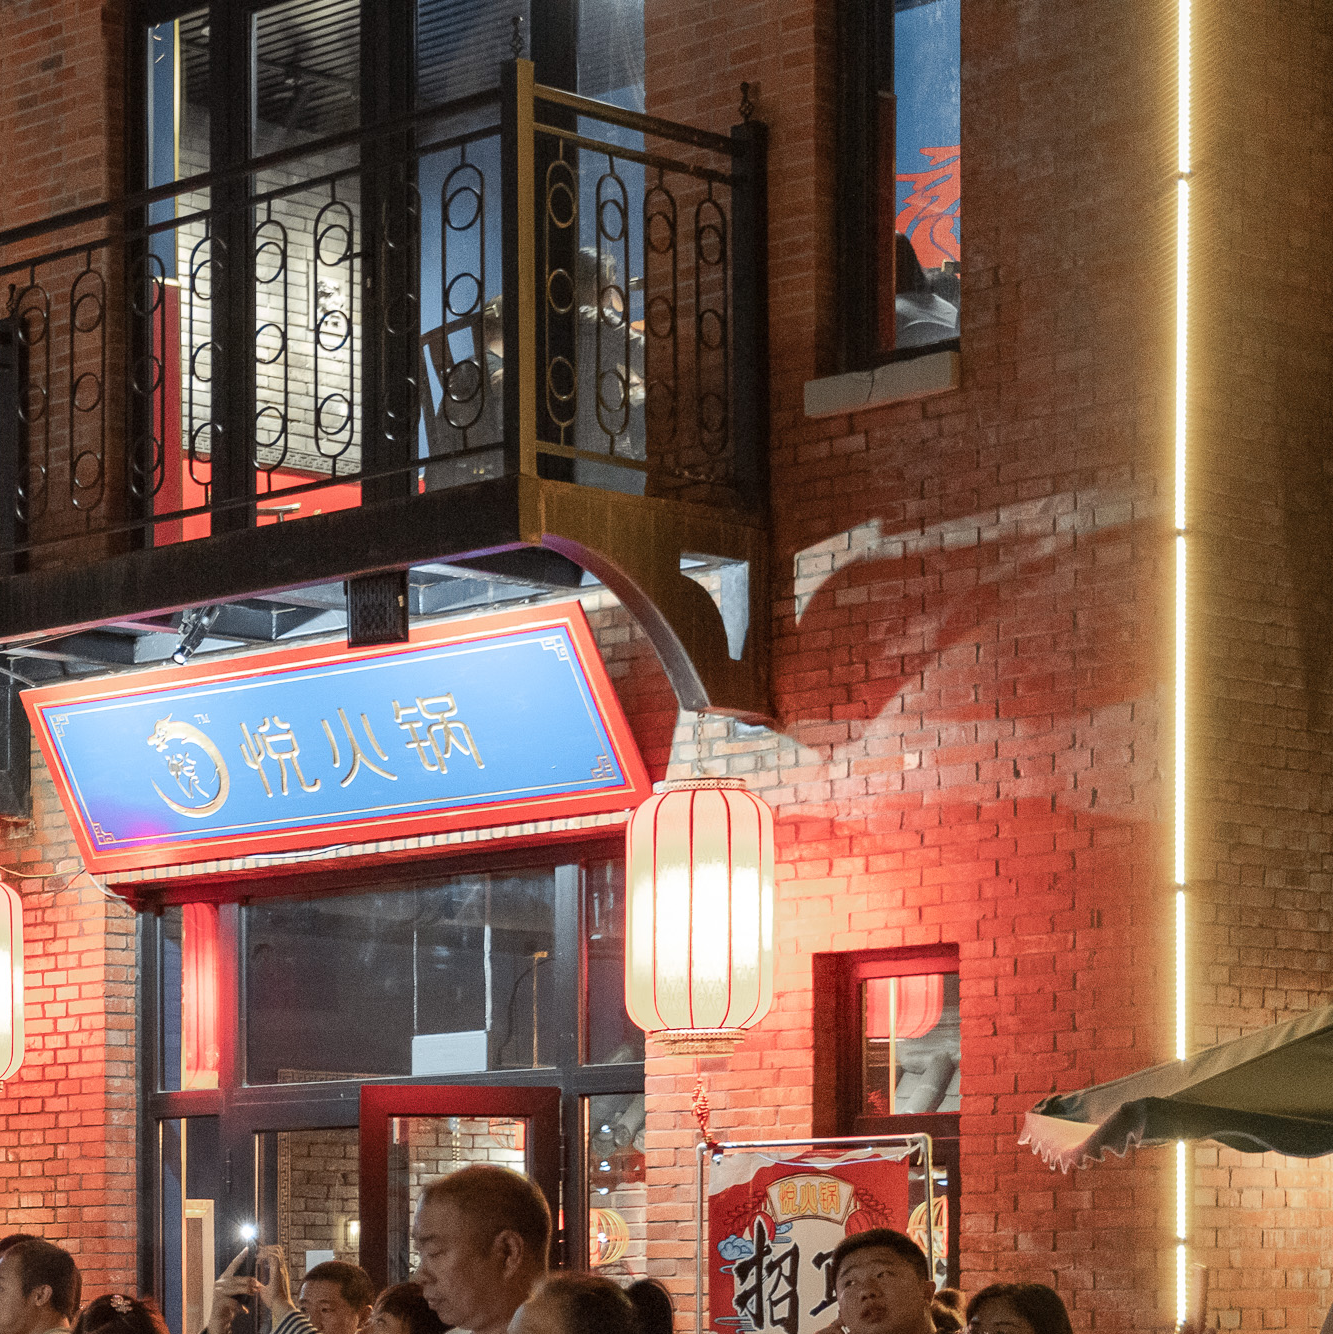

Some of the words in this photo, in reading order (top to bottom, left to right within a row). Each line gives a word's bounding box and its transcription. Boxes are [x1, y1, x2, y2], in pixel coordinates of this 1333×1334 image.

[240, 693, 486, 798] 悦火锅
[779, 1182, 841, 1216] 悦火锅
